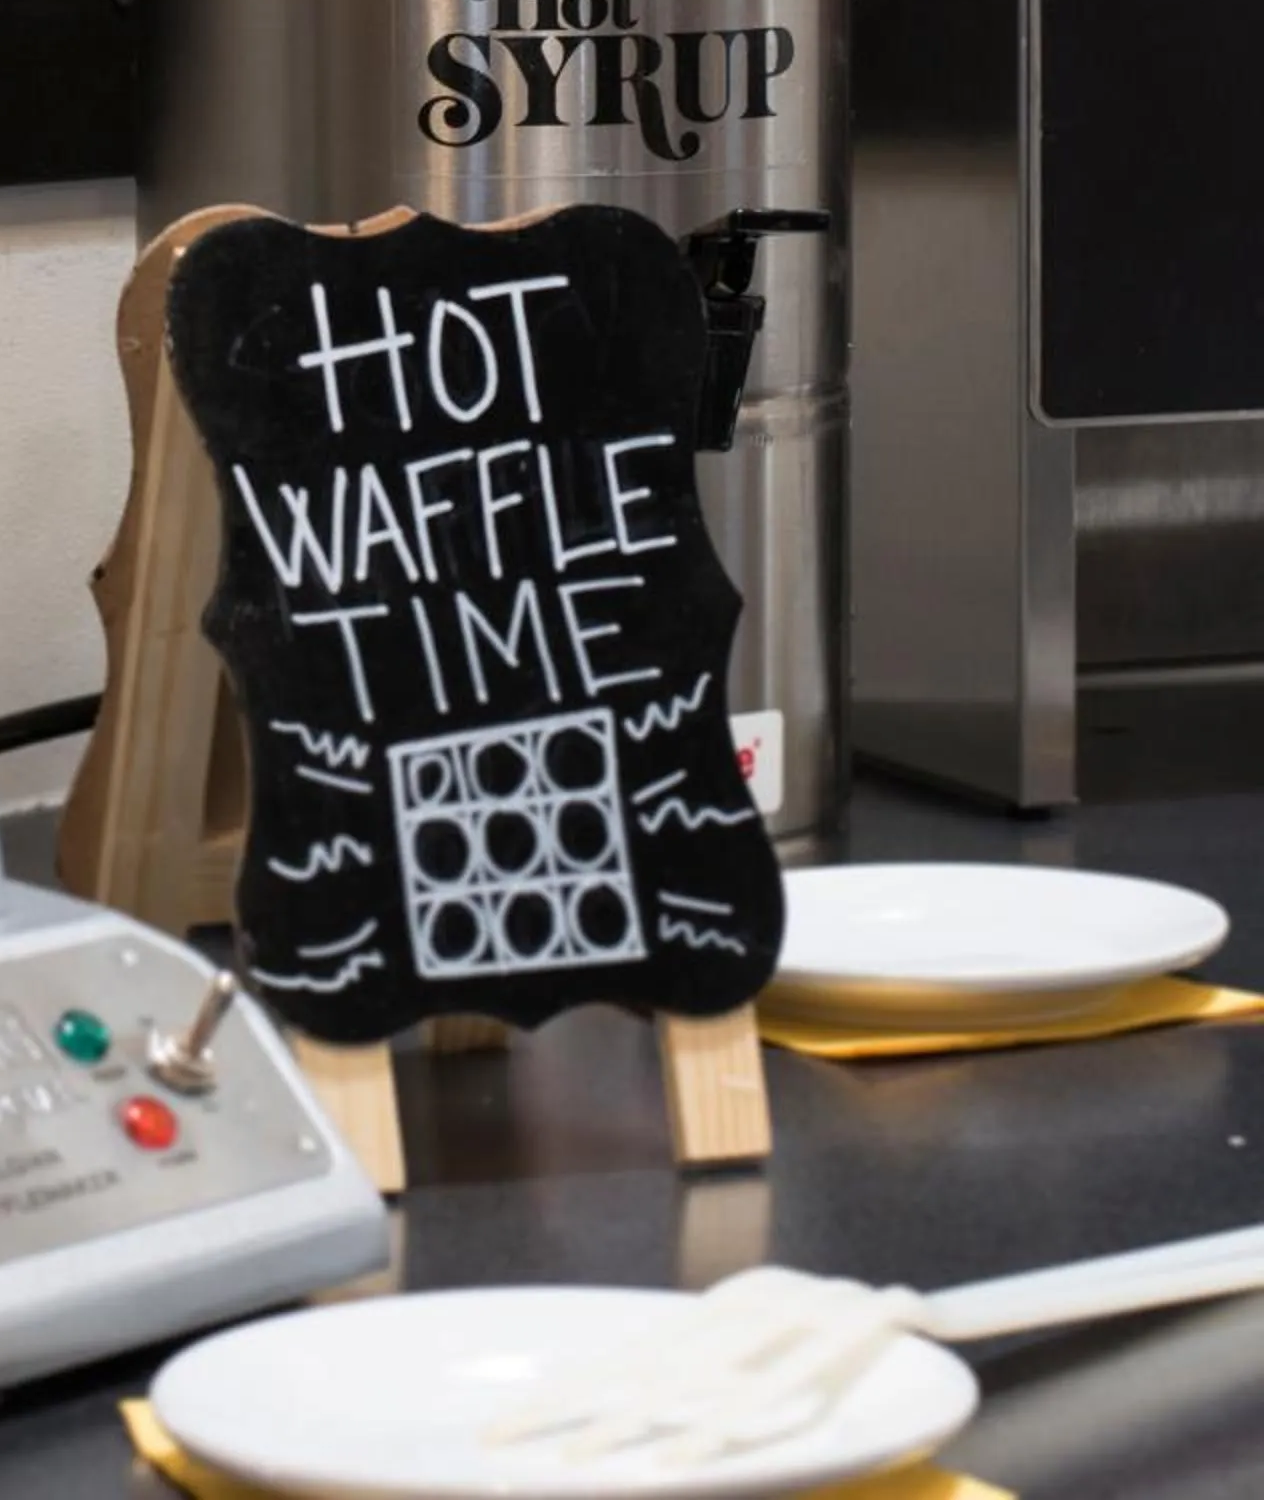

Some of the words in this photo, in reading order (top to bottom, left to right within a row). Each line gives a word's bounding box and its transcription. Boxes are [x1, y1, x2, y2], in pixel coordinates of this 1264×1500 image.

[418, 27, 794, 161] SYRUP
[299, 276, 568, 431] HOT
[234, 435, 678, 593] WAFFLE
[292, 579, 662, 722] TIME
